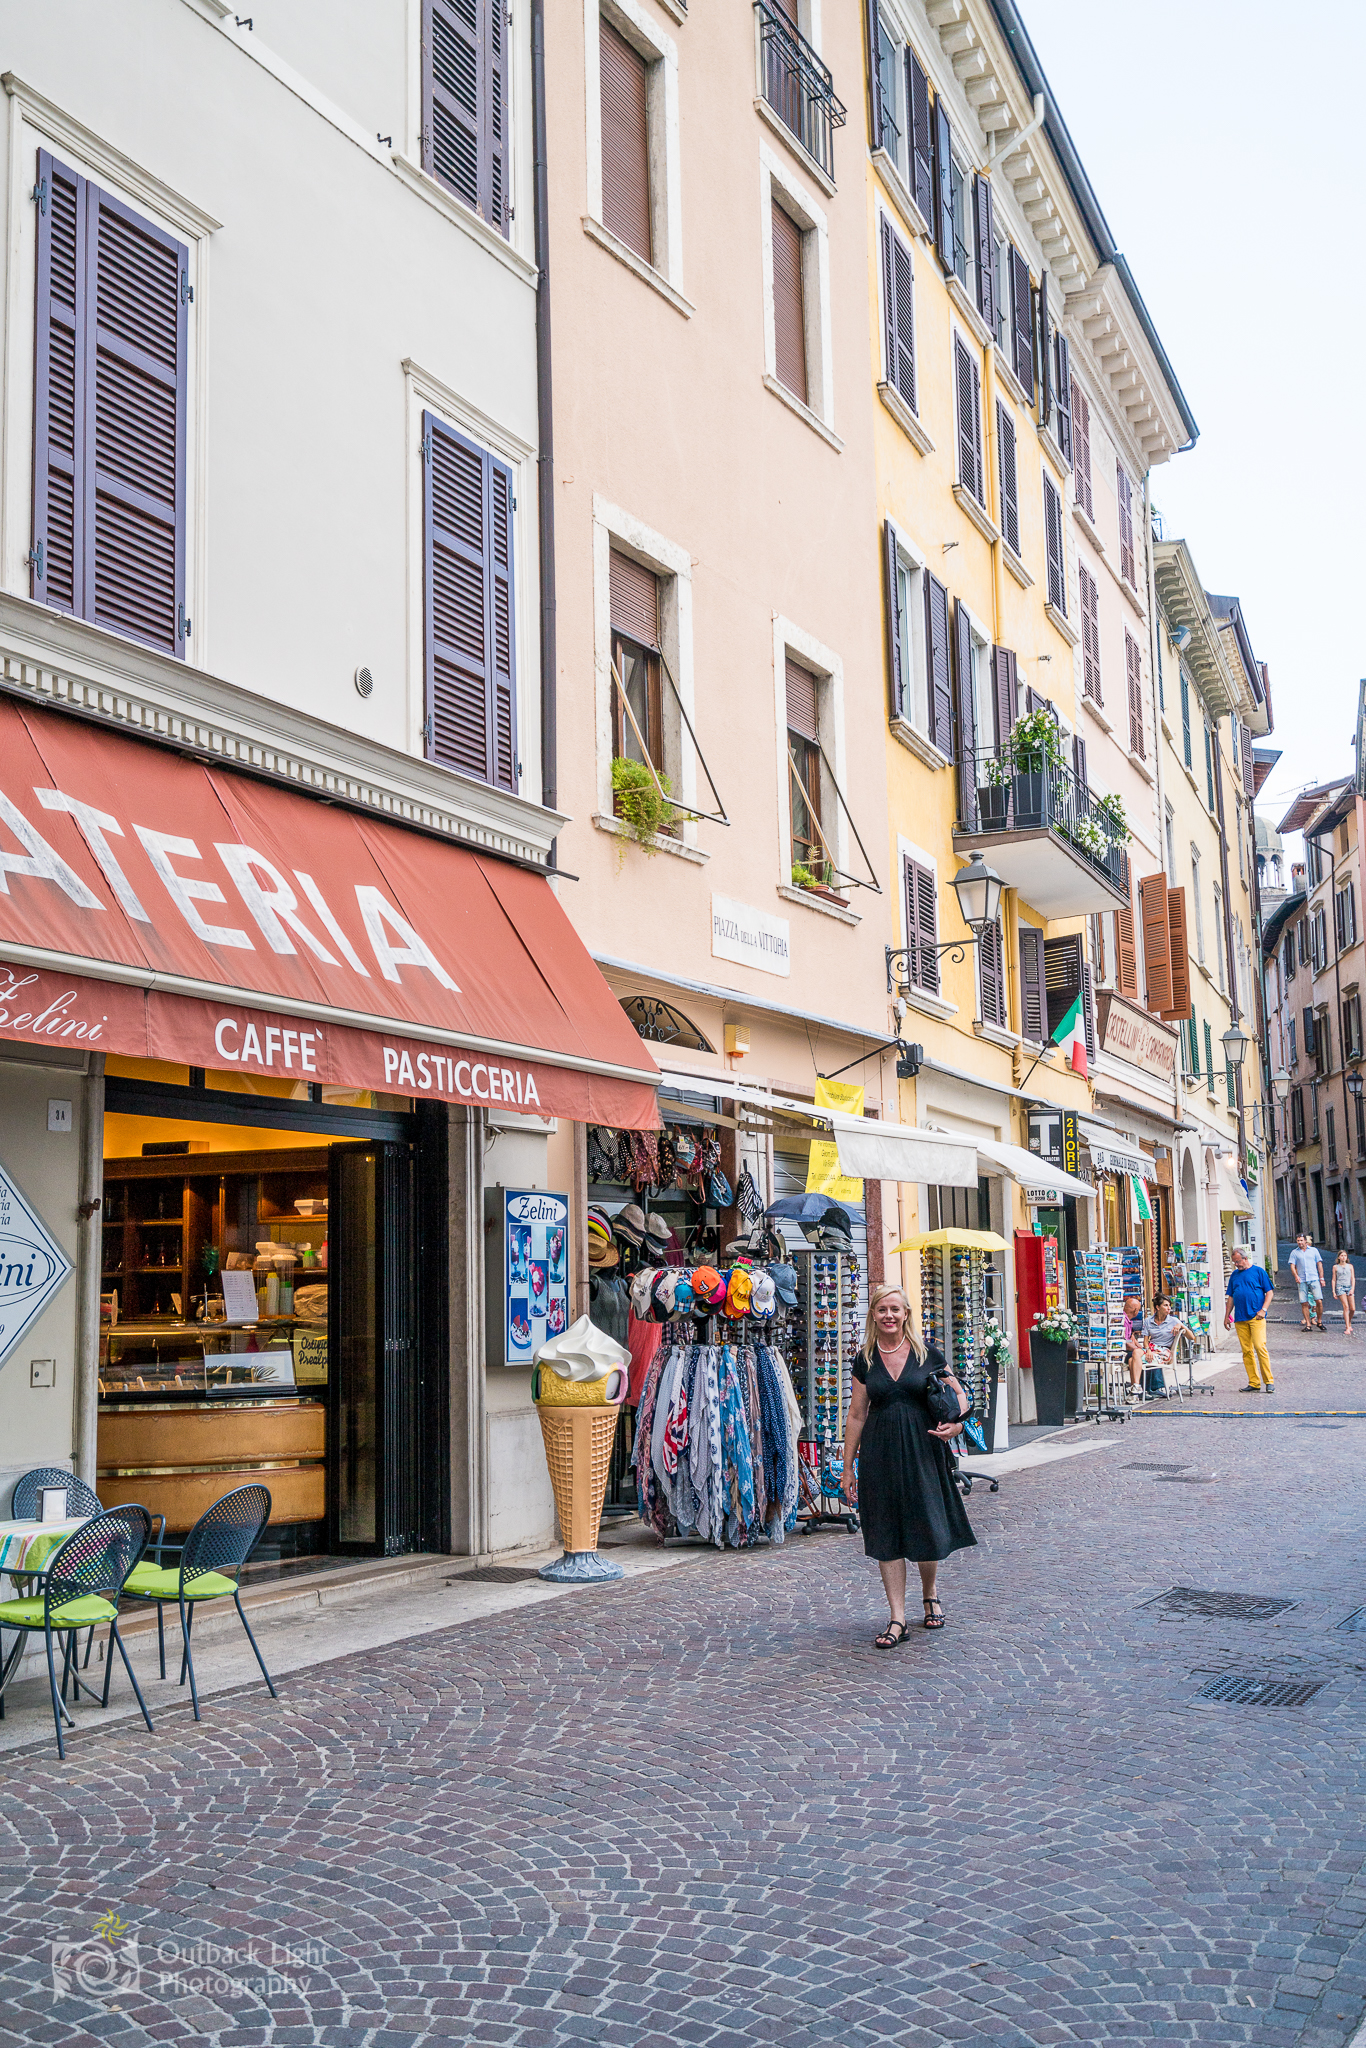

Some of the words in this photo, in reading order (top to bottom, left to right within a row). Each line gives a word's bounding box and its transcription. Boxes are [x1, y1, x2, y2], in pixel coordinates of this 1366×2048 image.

[713, 915, 739, 941] PIAZZA
[741, 930, 758, 948] DELLA
[758, 930, 789, 958] VITTORIA
[383, 1046, 541, 1107] PASTICCERIA
[1066, 1117, 1074, 1138] 24
[1065, 1140, 1076, 1172] ORE
[1027, 1189, 1046, 1197] LOTTO
[518, 1196, 558, 1221] Zelini
